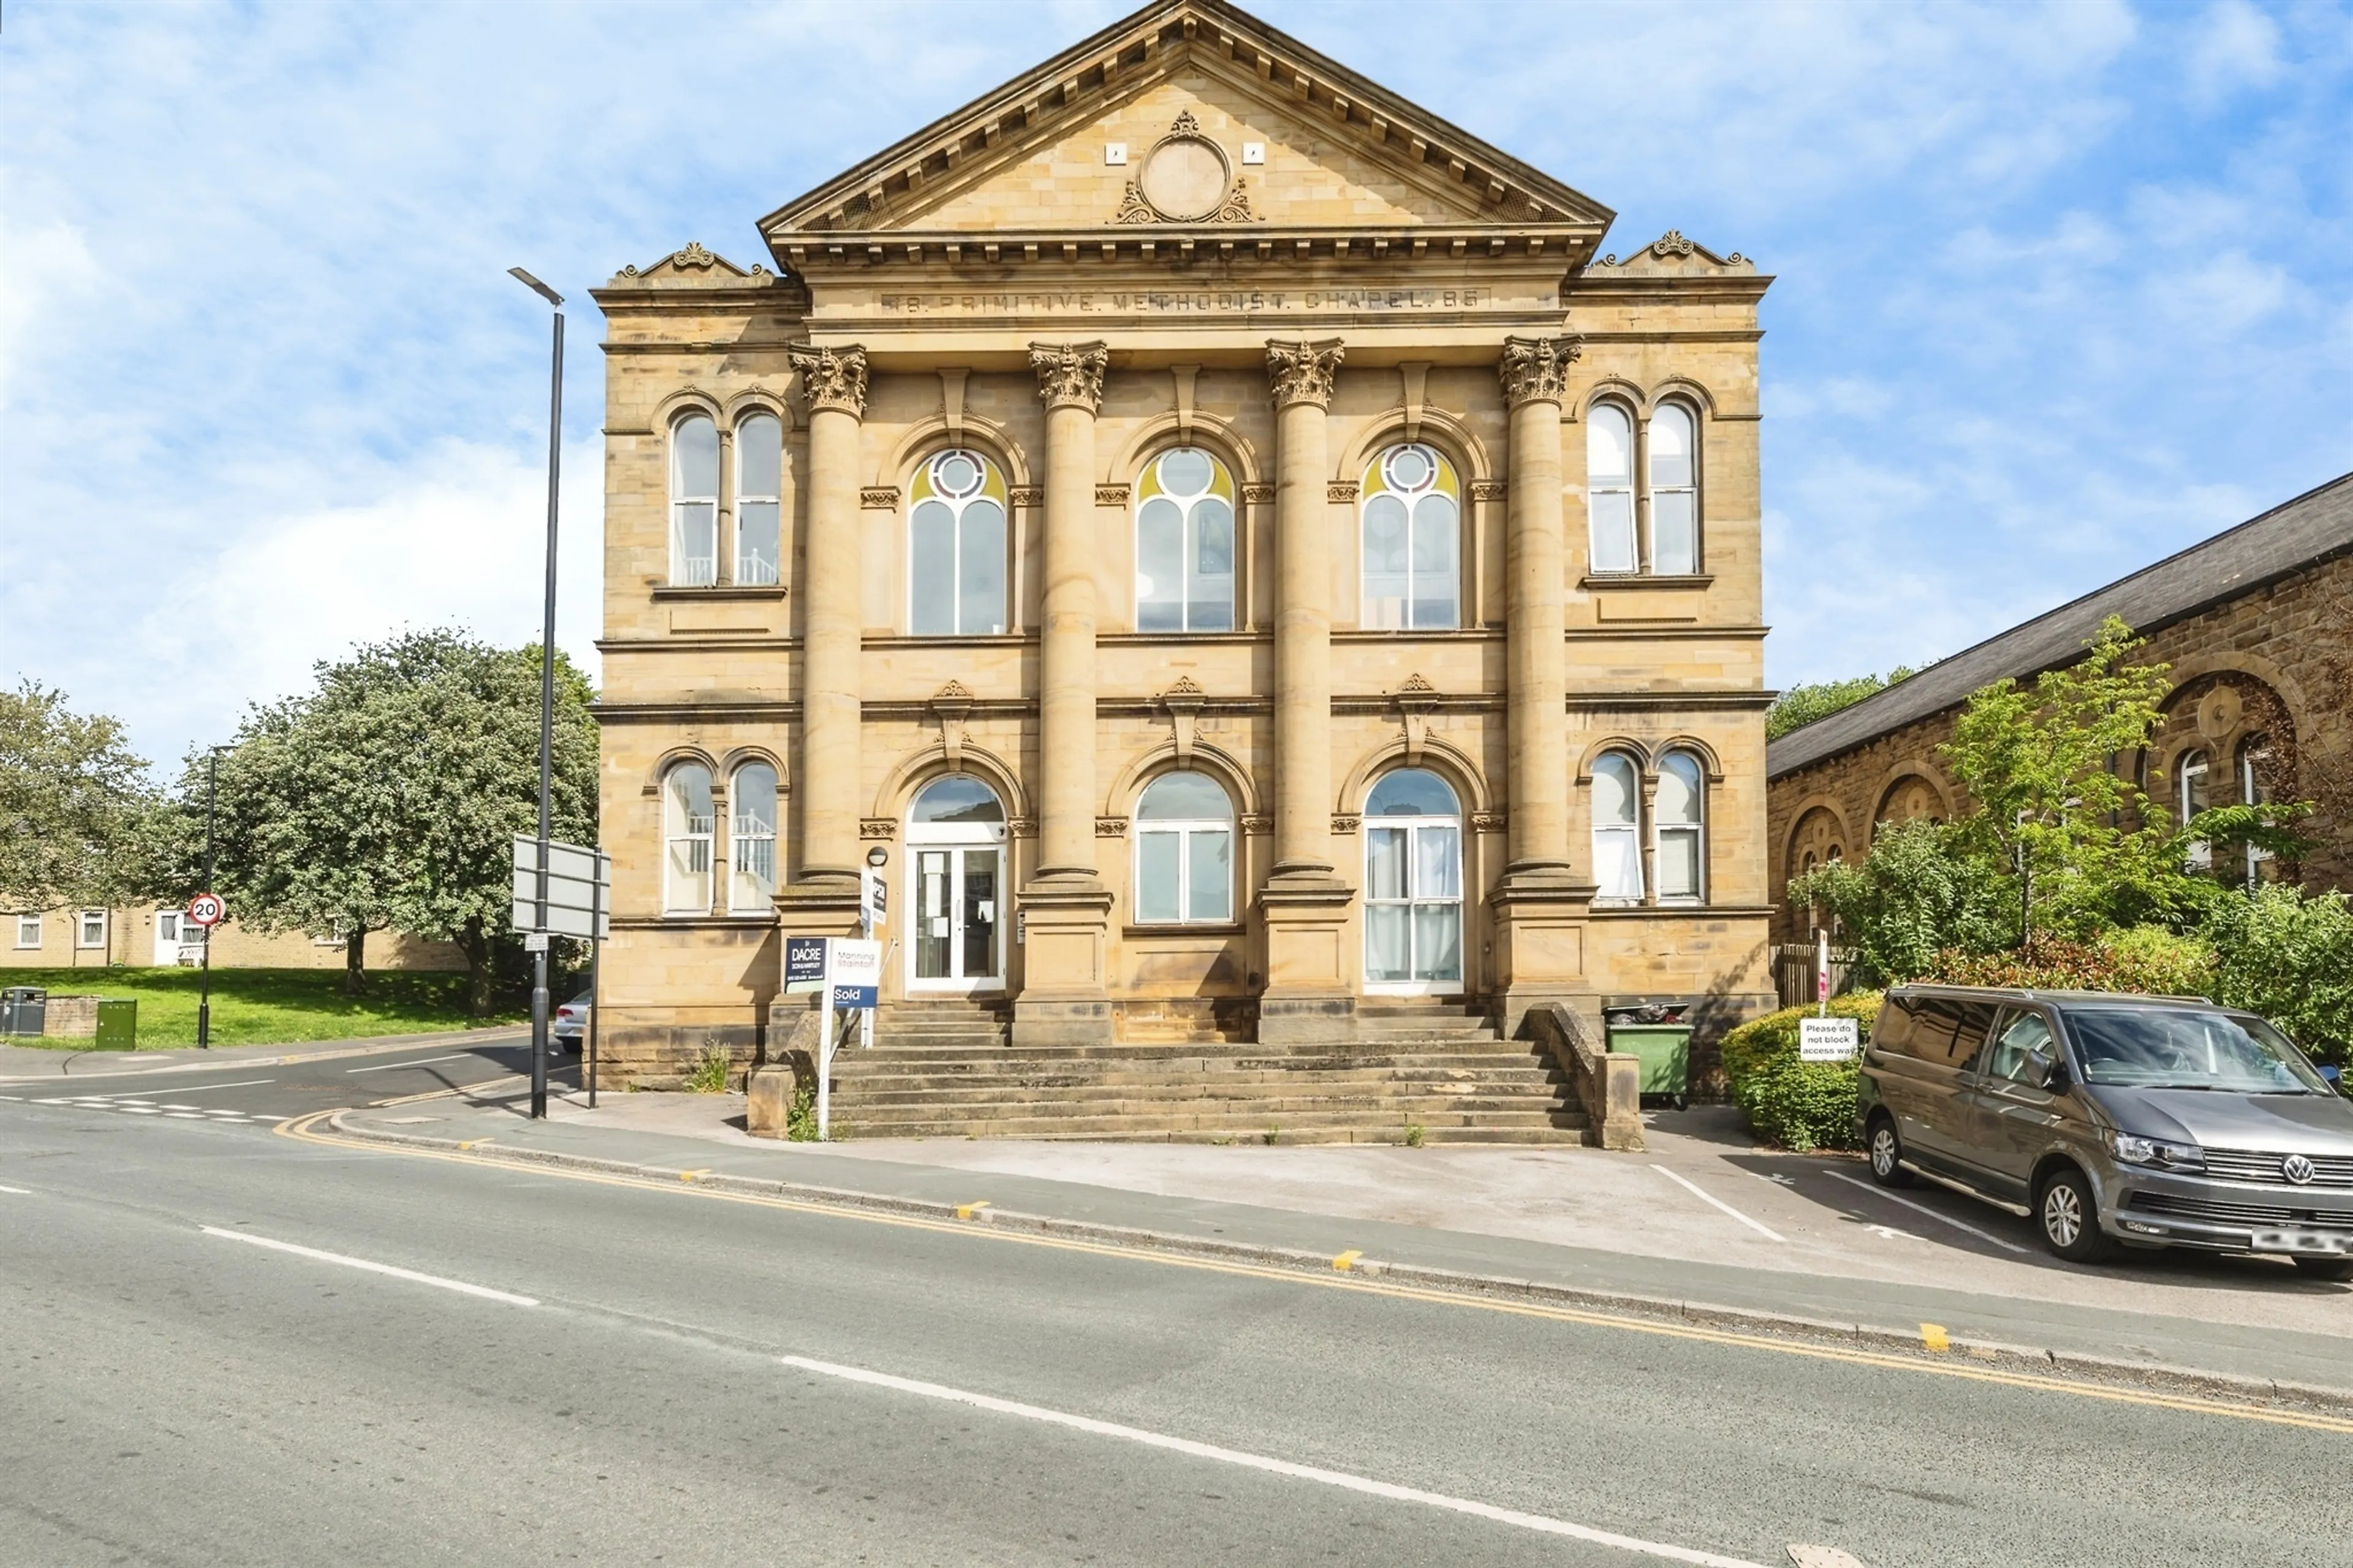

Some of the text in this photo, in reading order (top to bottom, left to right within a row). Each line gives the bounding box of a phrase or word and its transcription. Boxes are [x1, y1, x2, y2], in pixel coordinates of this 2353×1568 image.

[195, 904, 216, 915] 20
[792, 948, 821, 961] DACRE
[838, 952, 875, 960] Manning
[835, 988, 860, 1000] Sold
